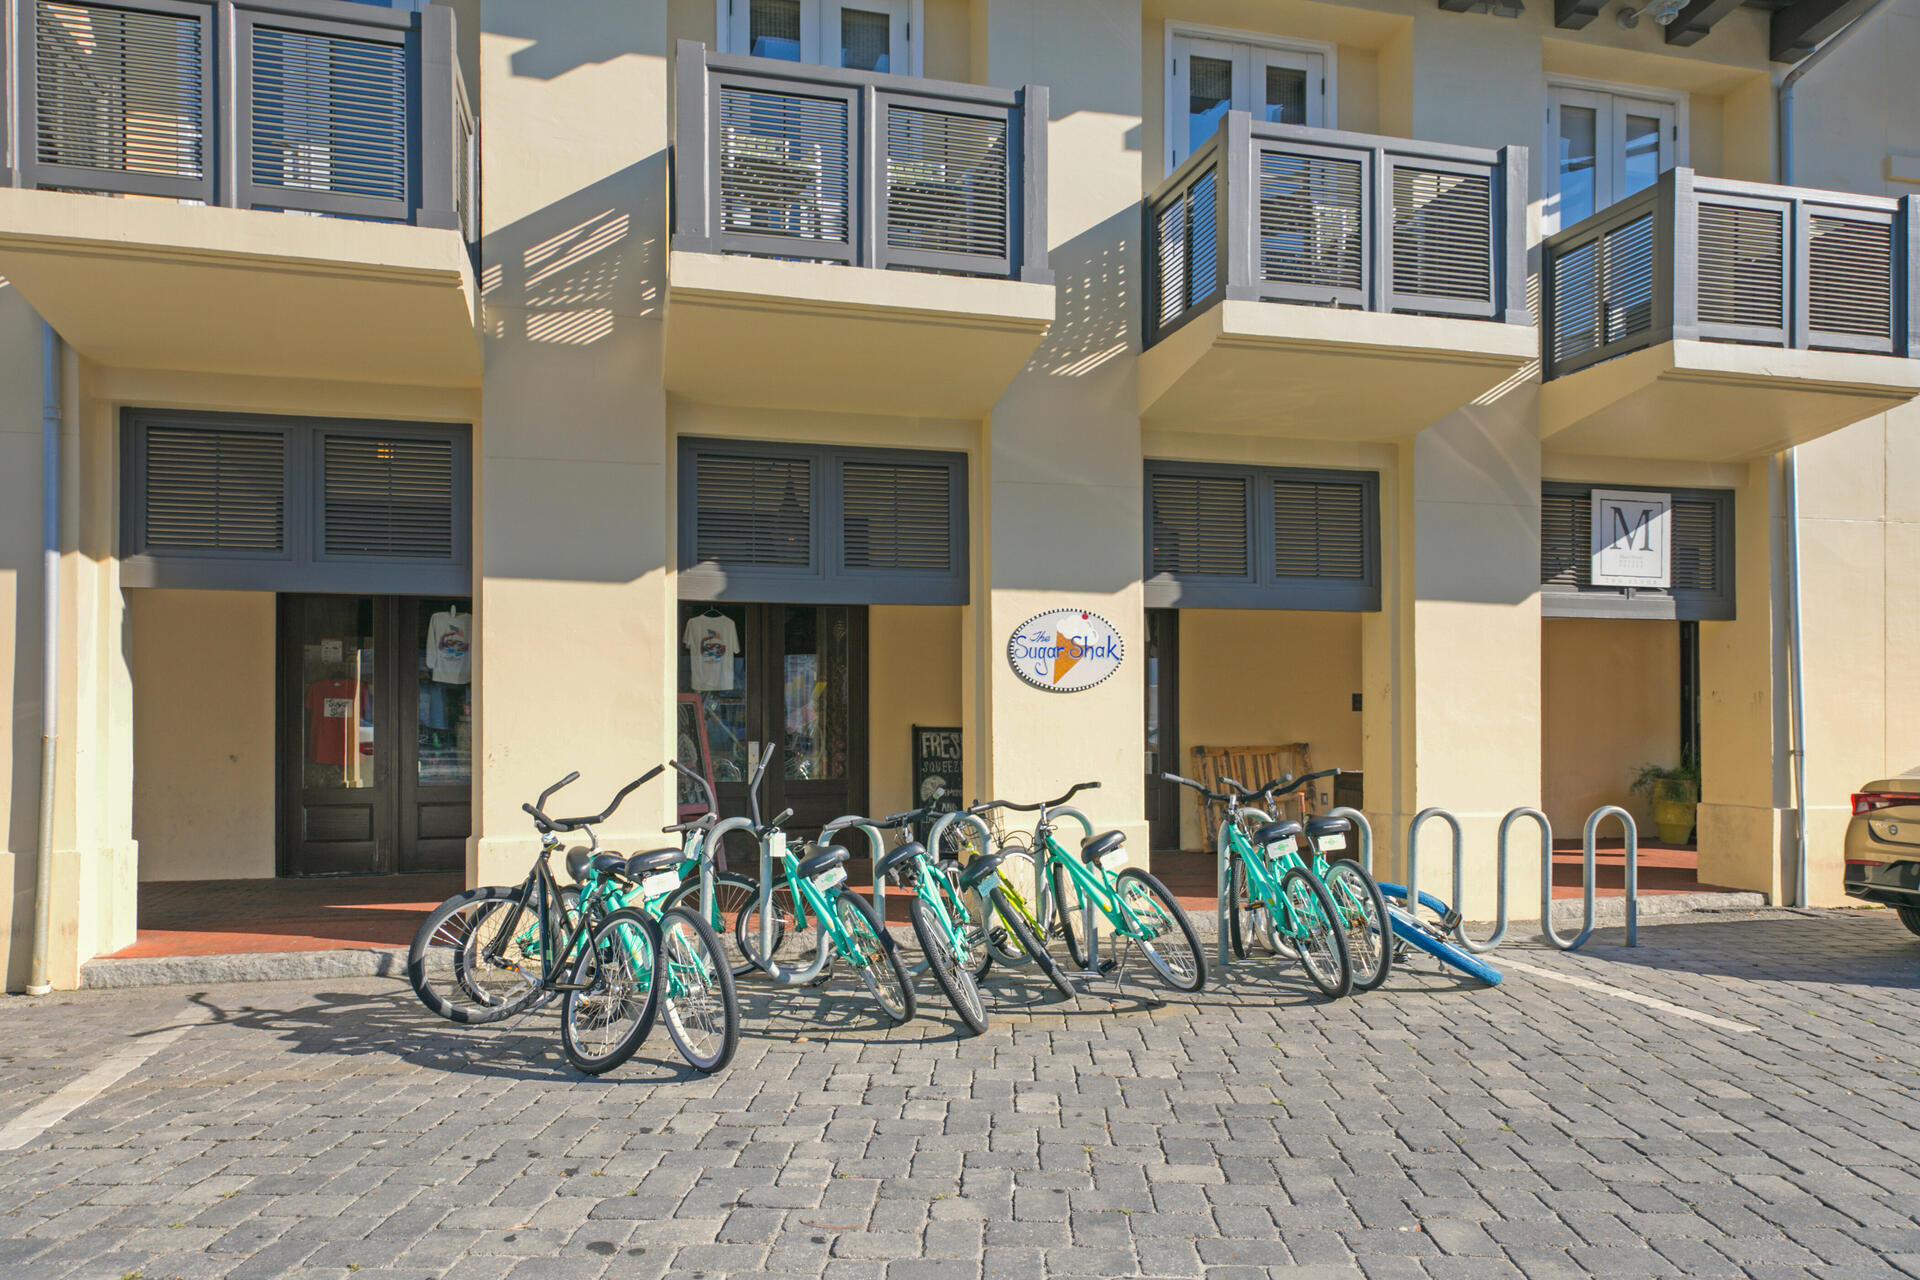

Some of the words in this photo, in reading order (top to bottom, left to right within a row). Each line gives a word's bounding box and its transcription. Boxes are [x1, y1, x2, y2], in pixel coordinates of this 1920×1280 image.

[1610, 506, 1654, 551] M
[1029, 631, 1051, 642] The
[1014, 635, 1064, 676] Sugar
[1069, 634, 1120, 661] Shak
[922, 732, 961, 759] FRES
[921, 761, 960, 773] SQUEEZ
